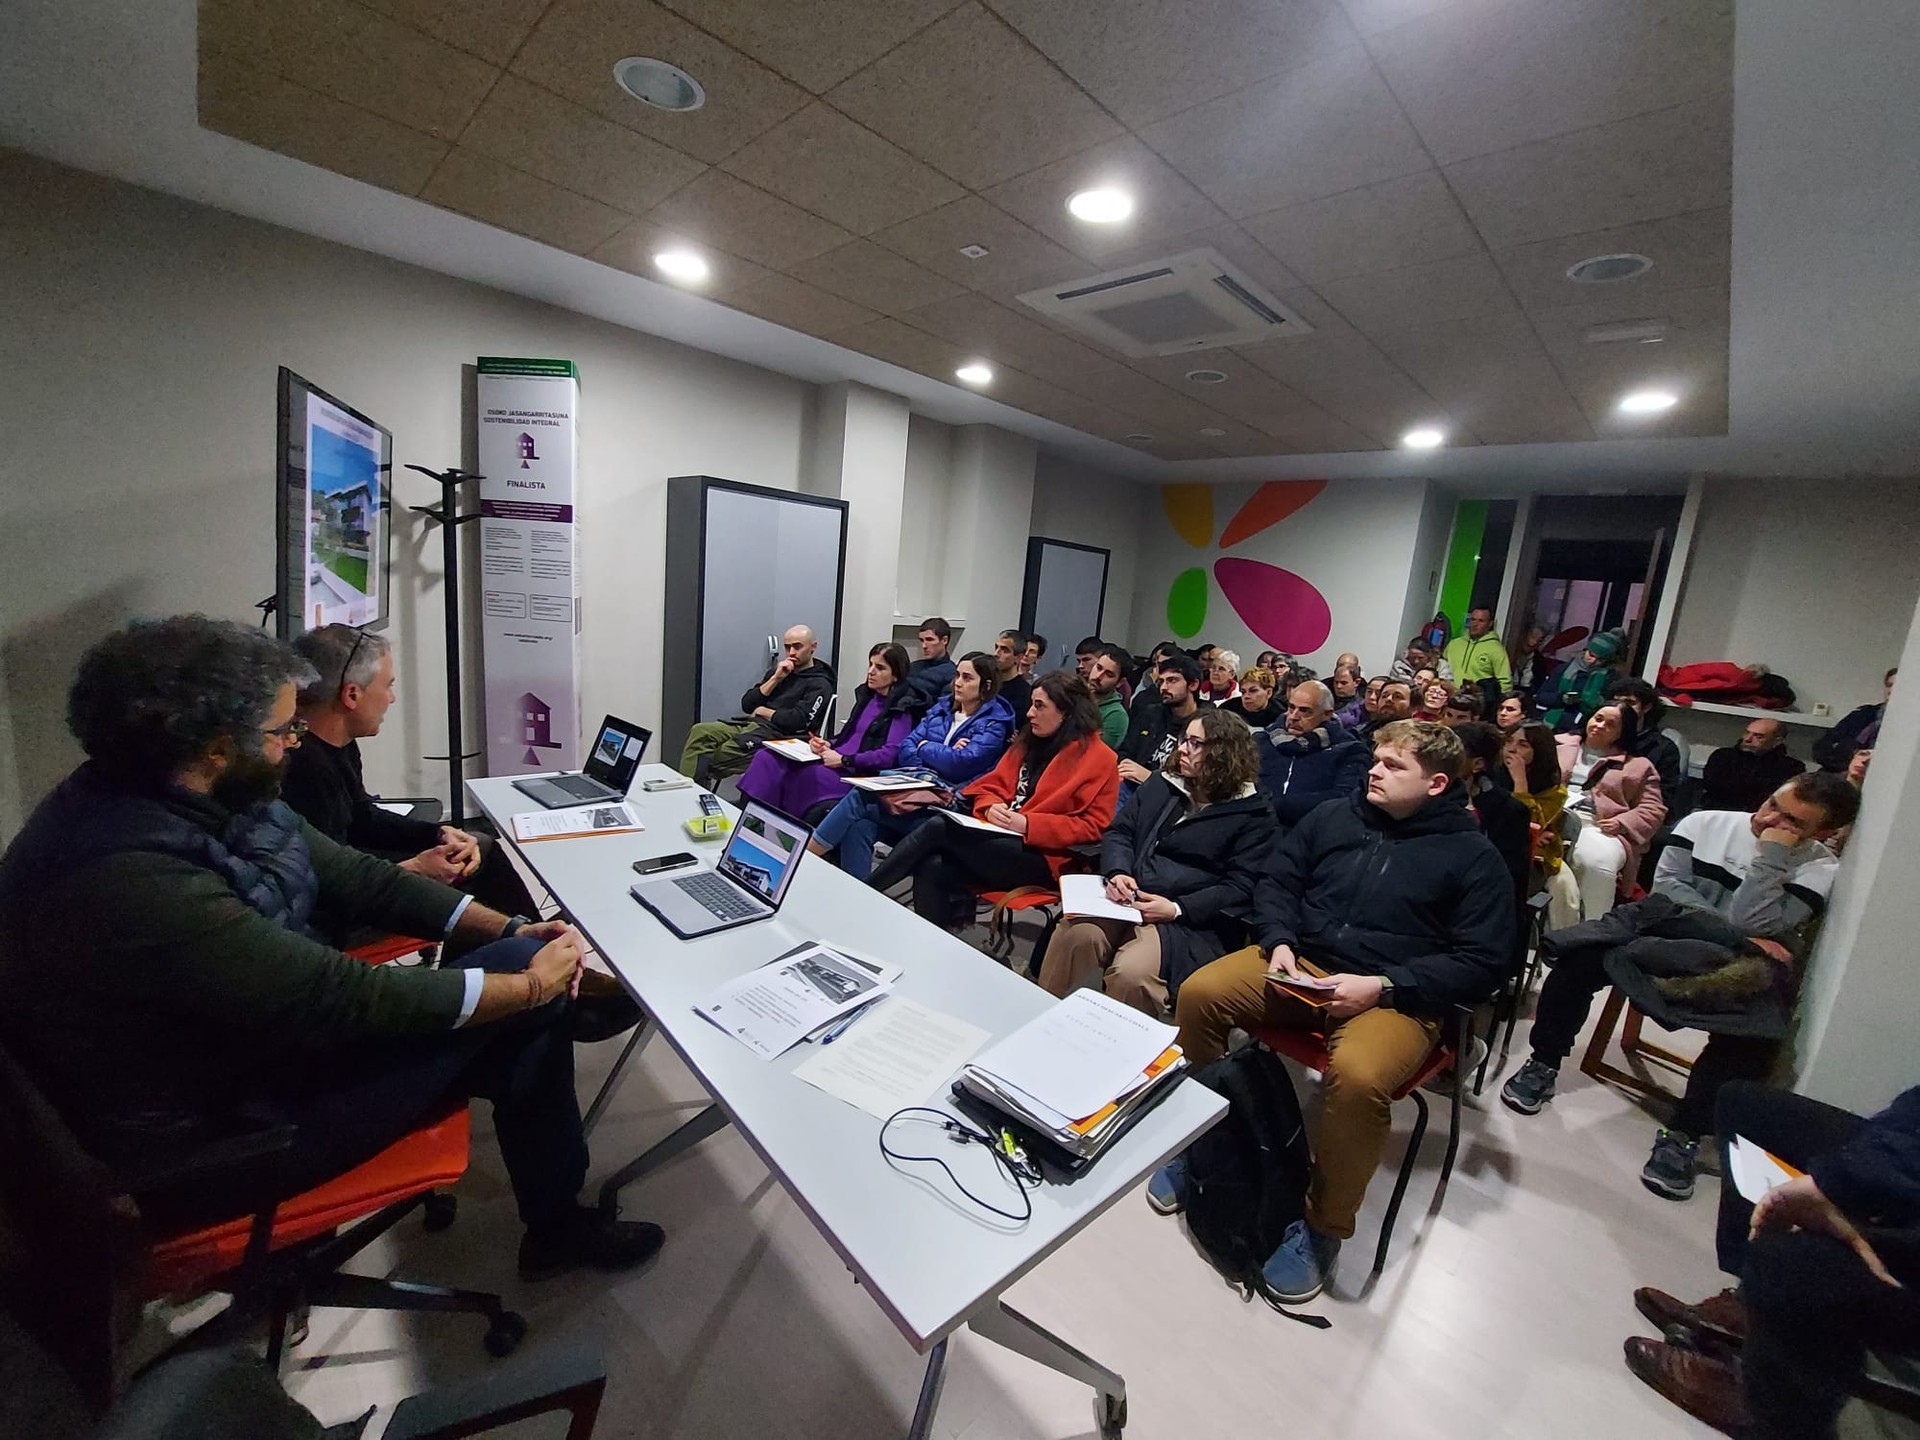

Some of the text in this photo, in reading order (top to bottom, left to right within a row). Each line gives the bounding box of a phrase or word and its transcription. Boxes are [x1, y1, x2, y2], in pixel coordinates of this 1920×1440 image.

[508, 410, 569, 419] JASANGARRITASUNA
[483, 417, 560, 427] SOSTENIBILIDAD INTEGRAL
[506, 480, 546, 490] FINALISTA
